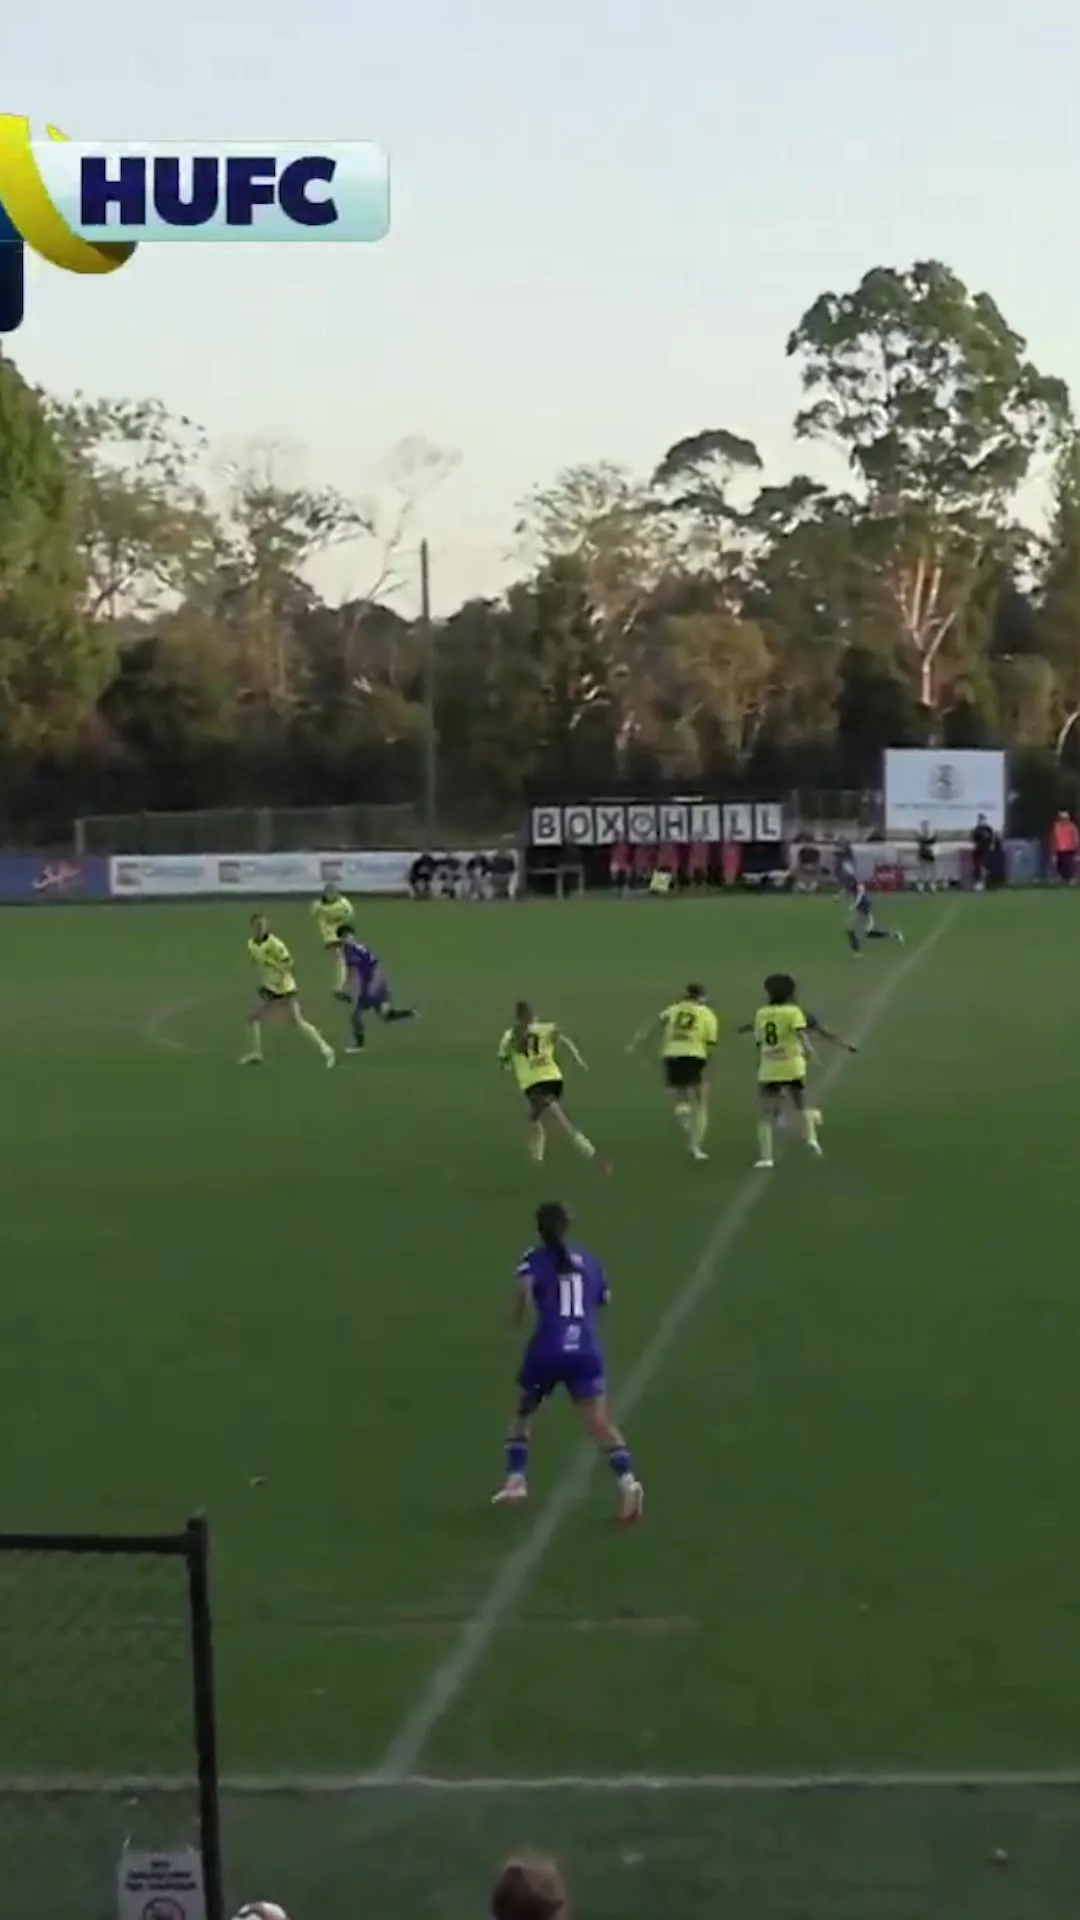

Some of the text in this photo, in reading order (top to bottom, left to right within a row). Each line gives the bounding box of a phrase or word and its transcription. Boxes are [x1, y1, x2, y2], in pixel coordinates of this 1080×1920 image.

[537, 808, 777, 839] BOX HILL
[765, 1021, 779, 1046] 8
[559, 1272, 584, 1317] 11
